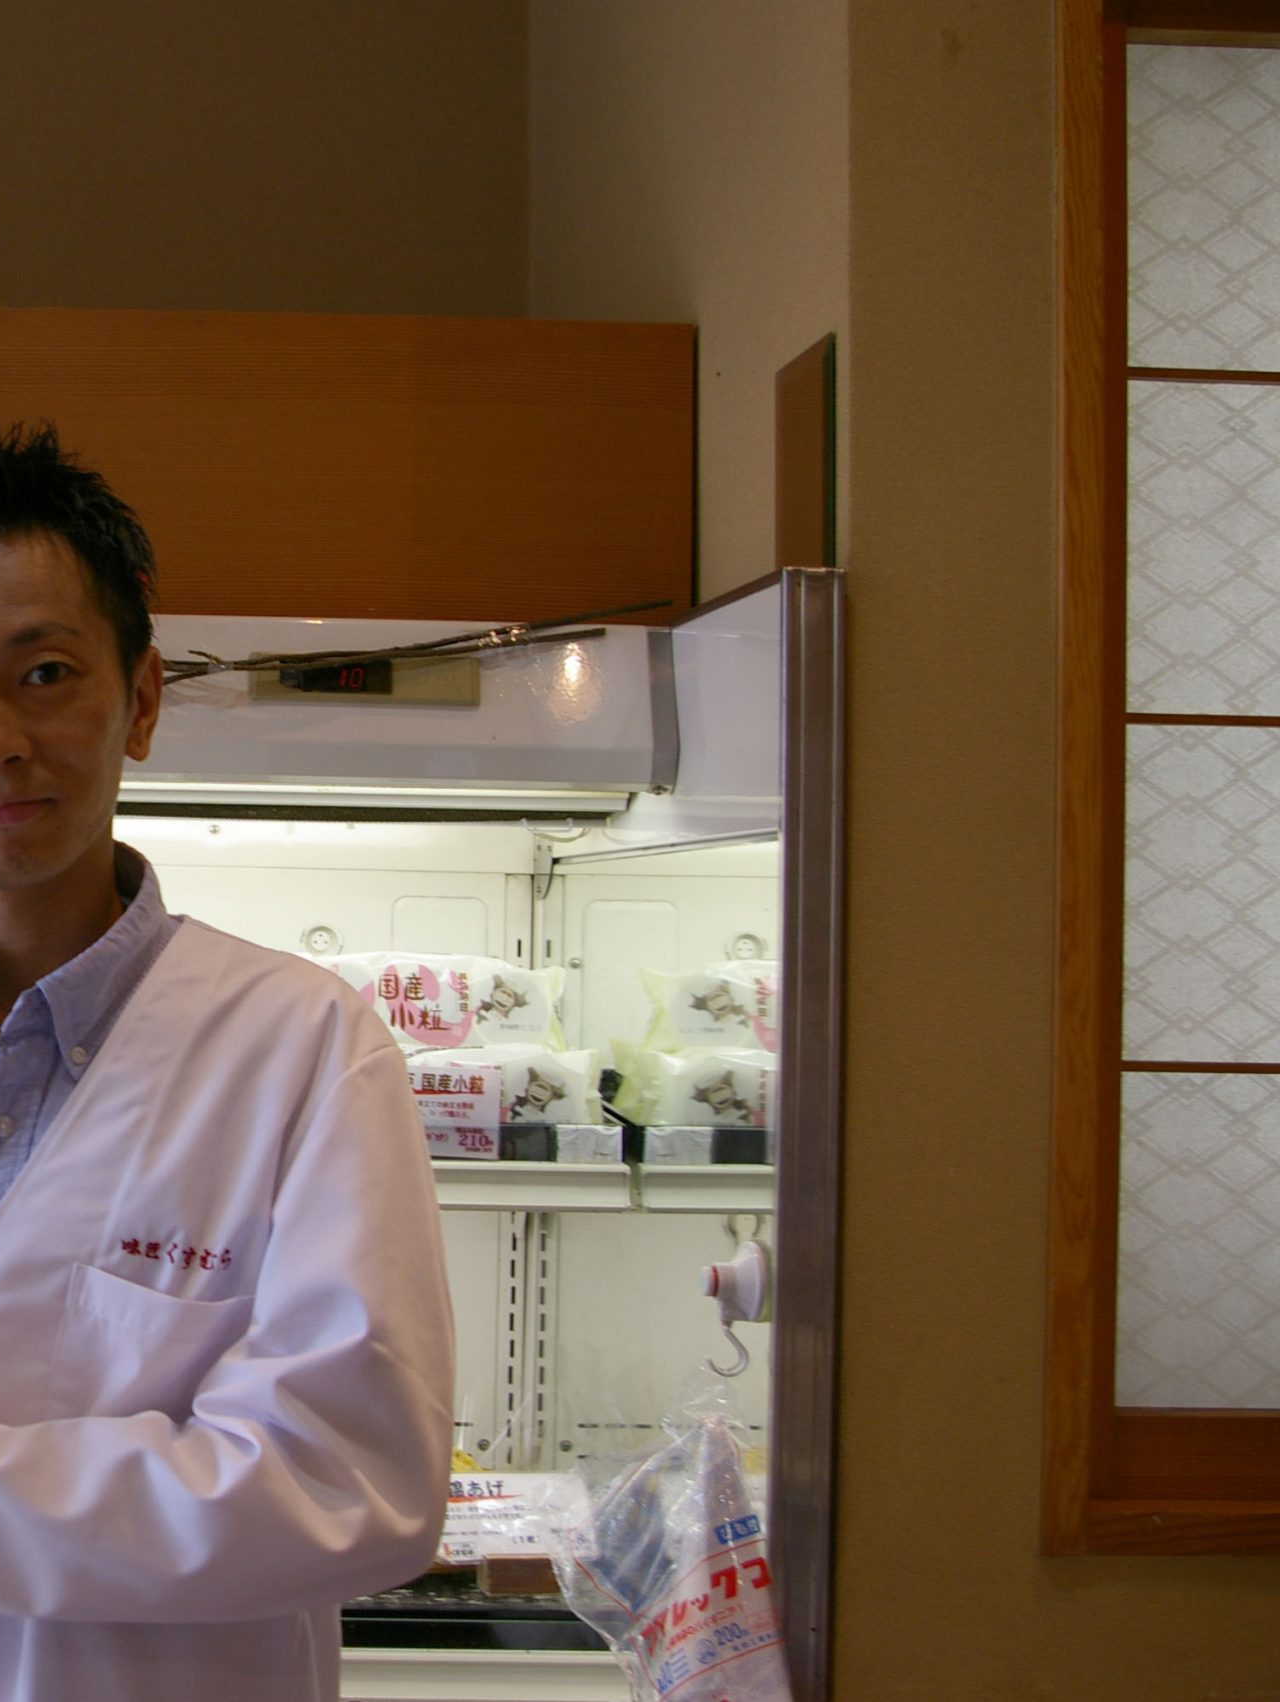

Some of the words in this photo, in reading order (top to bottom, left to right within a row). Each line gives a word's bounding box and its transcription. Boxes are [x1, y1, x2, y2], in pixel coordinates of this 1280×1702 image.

[339, 668, 364, 688] 10
[378, 972, 425, 1001] 国産
[390, 1003, 452, 1031] 小粒
